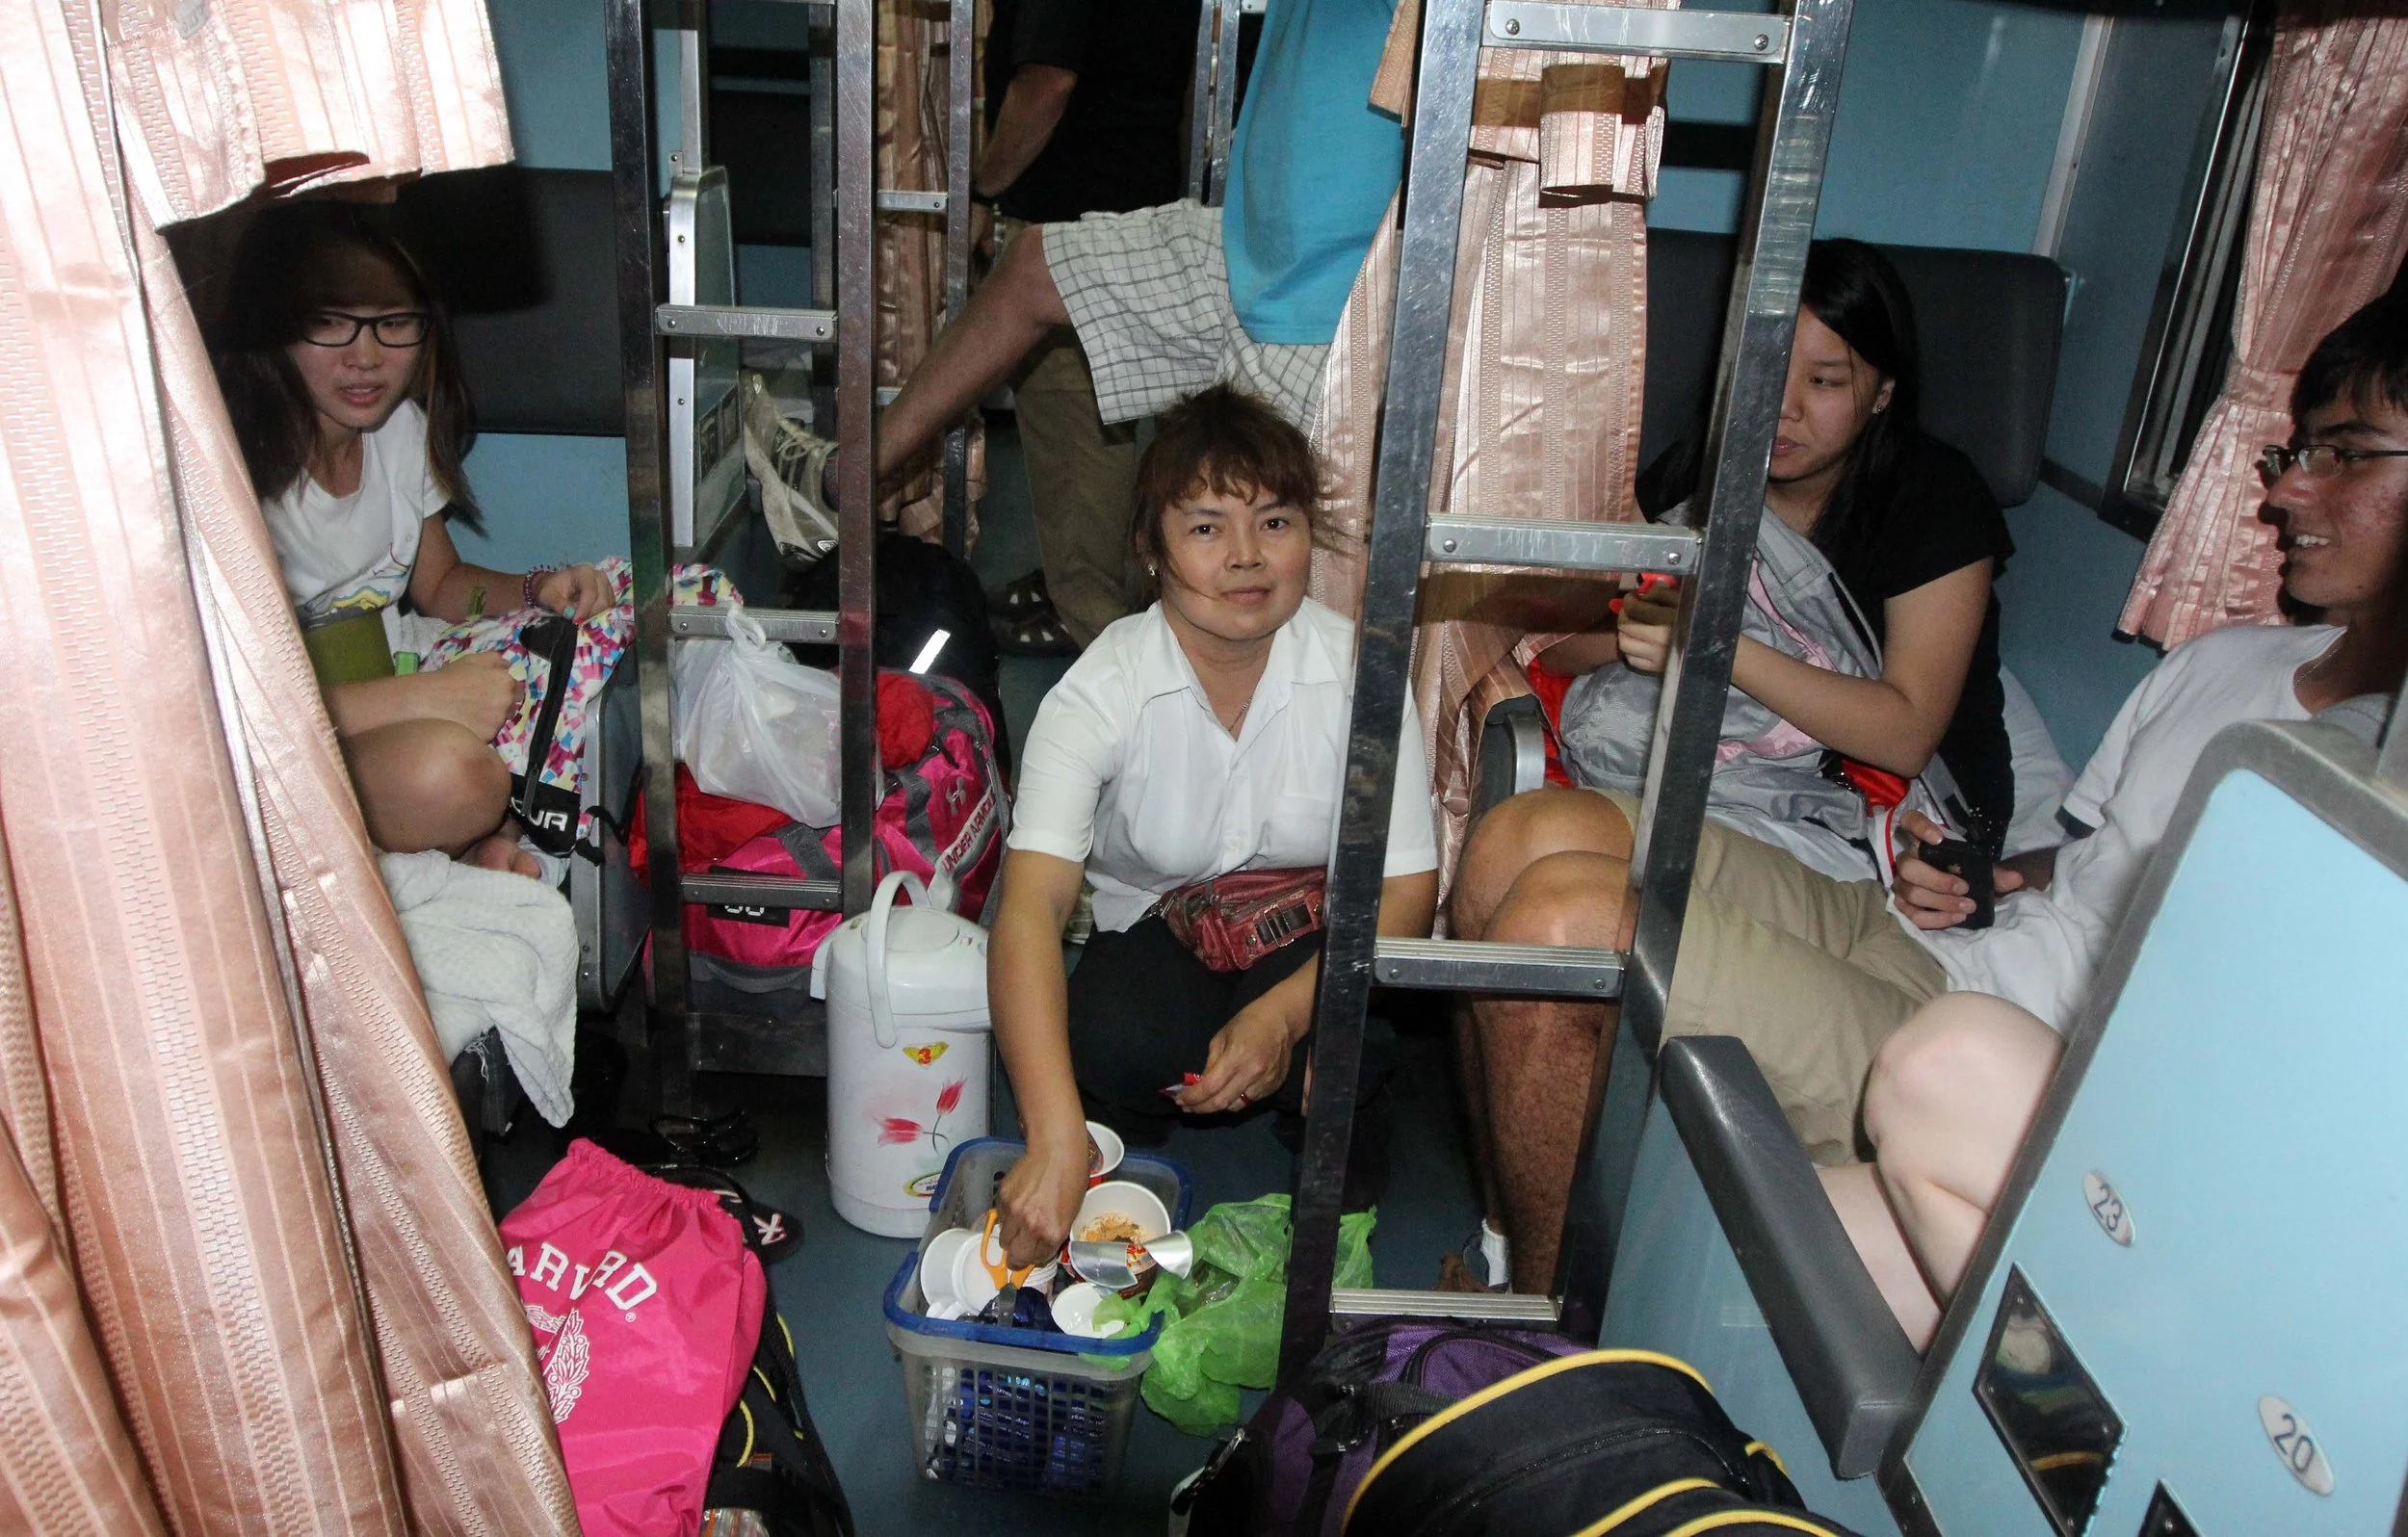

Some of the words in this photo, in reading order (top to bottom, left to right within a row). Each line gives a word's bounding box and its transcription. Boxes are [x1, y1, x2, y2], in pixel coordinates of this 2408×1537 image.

[941, 831, 974, 873] UNDER
[917, 1048, 931, 1064] 3
[2093, 1184, 2123, 1232] 23
[507, 1241, 657, 1310] ARVRD
[2274, 1413, 2315, 1473] 20
